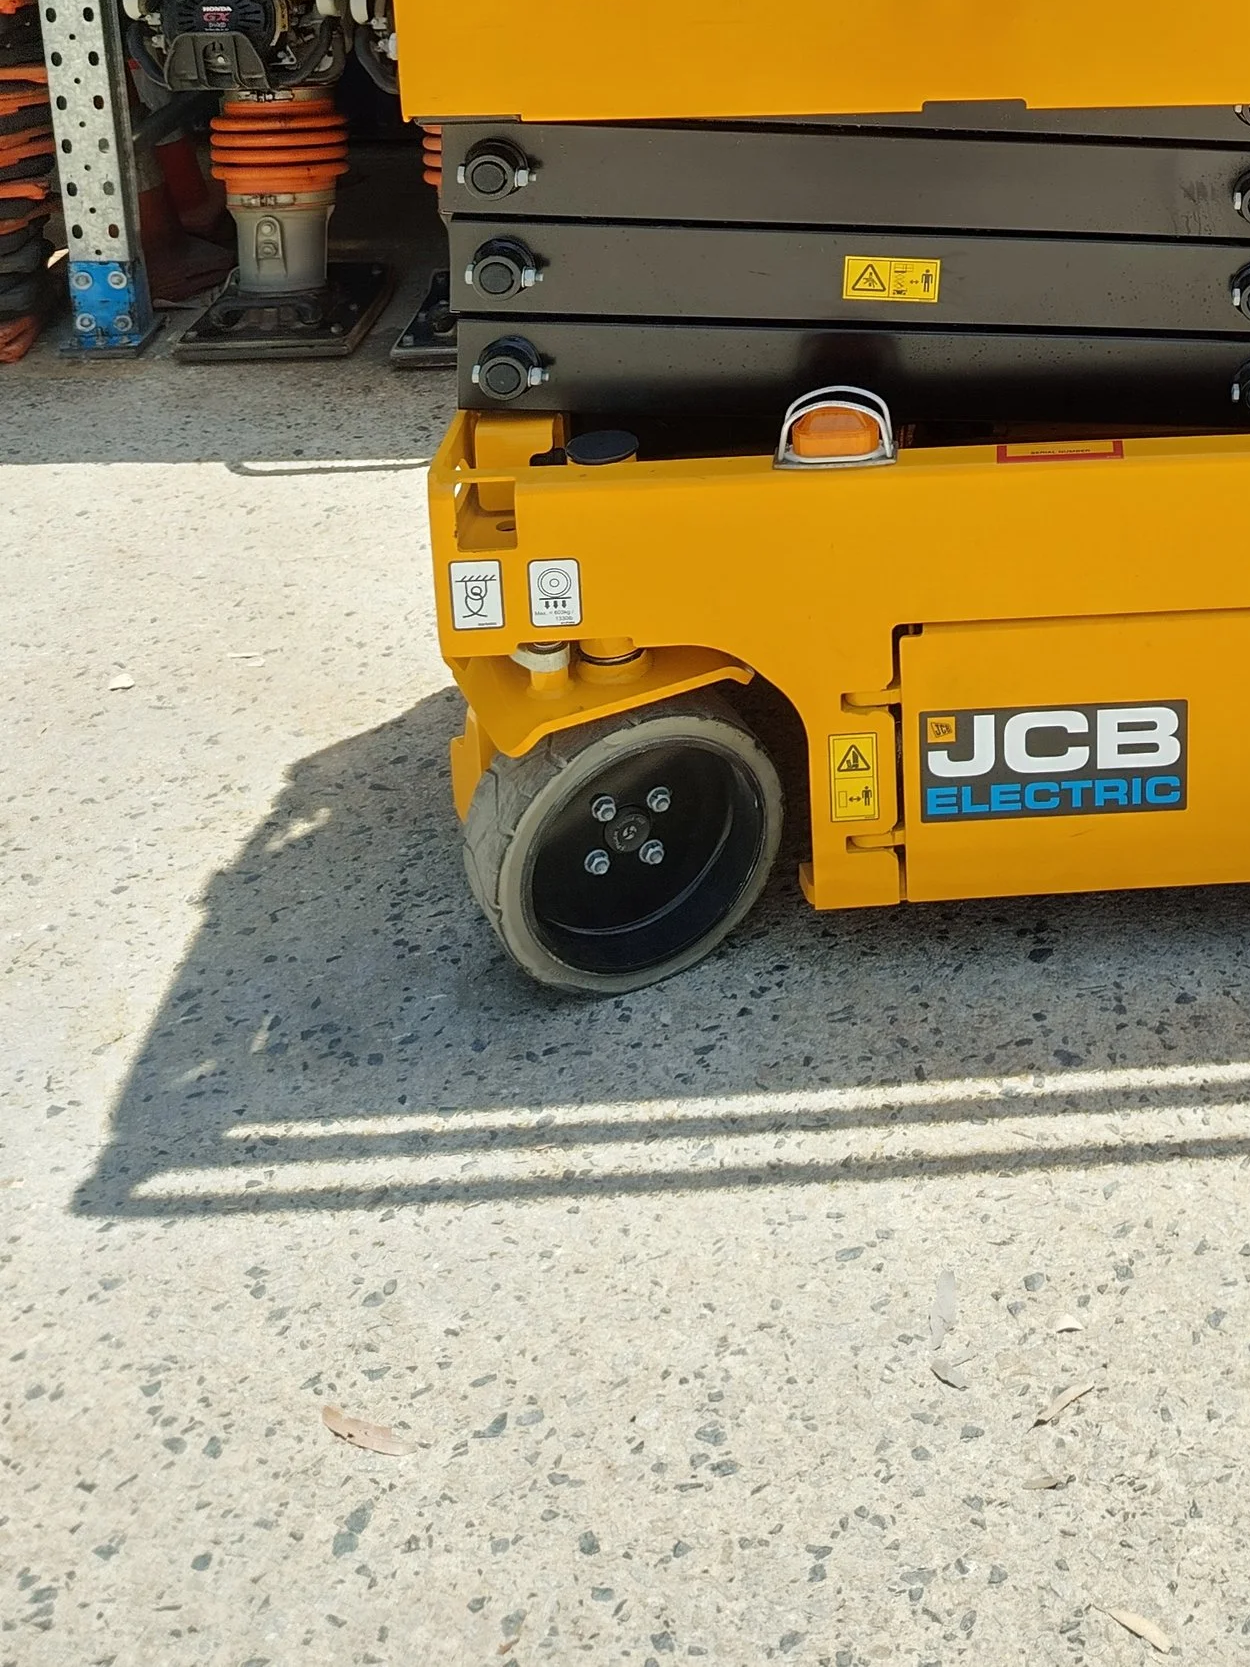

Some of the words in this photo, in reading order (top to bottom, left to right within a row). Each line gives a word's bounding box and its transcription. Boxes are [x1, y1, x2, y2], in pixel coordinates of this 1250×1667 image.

[203, 13, 230, 22] GX
[928, 707, 1181, 778] JCB
[933, 722, 952, 736] JCB
[927, 775, 1181, 815] ELECTRIC
